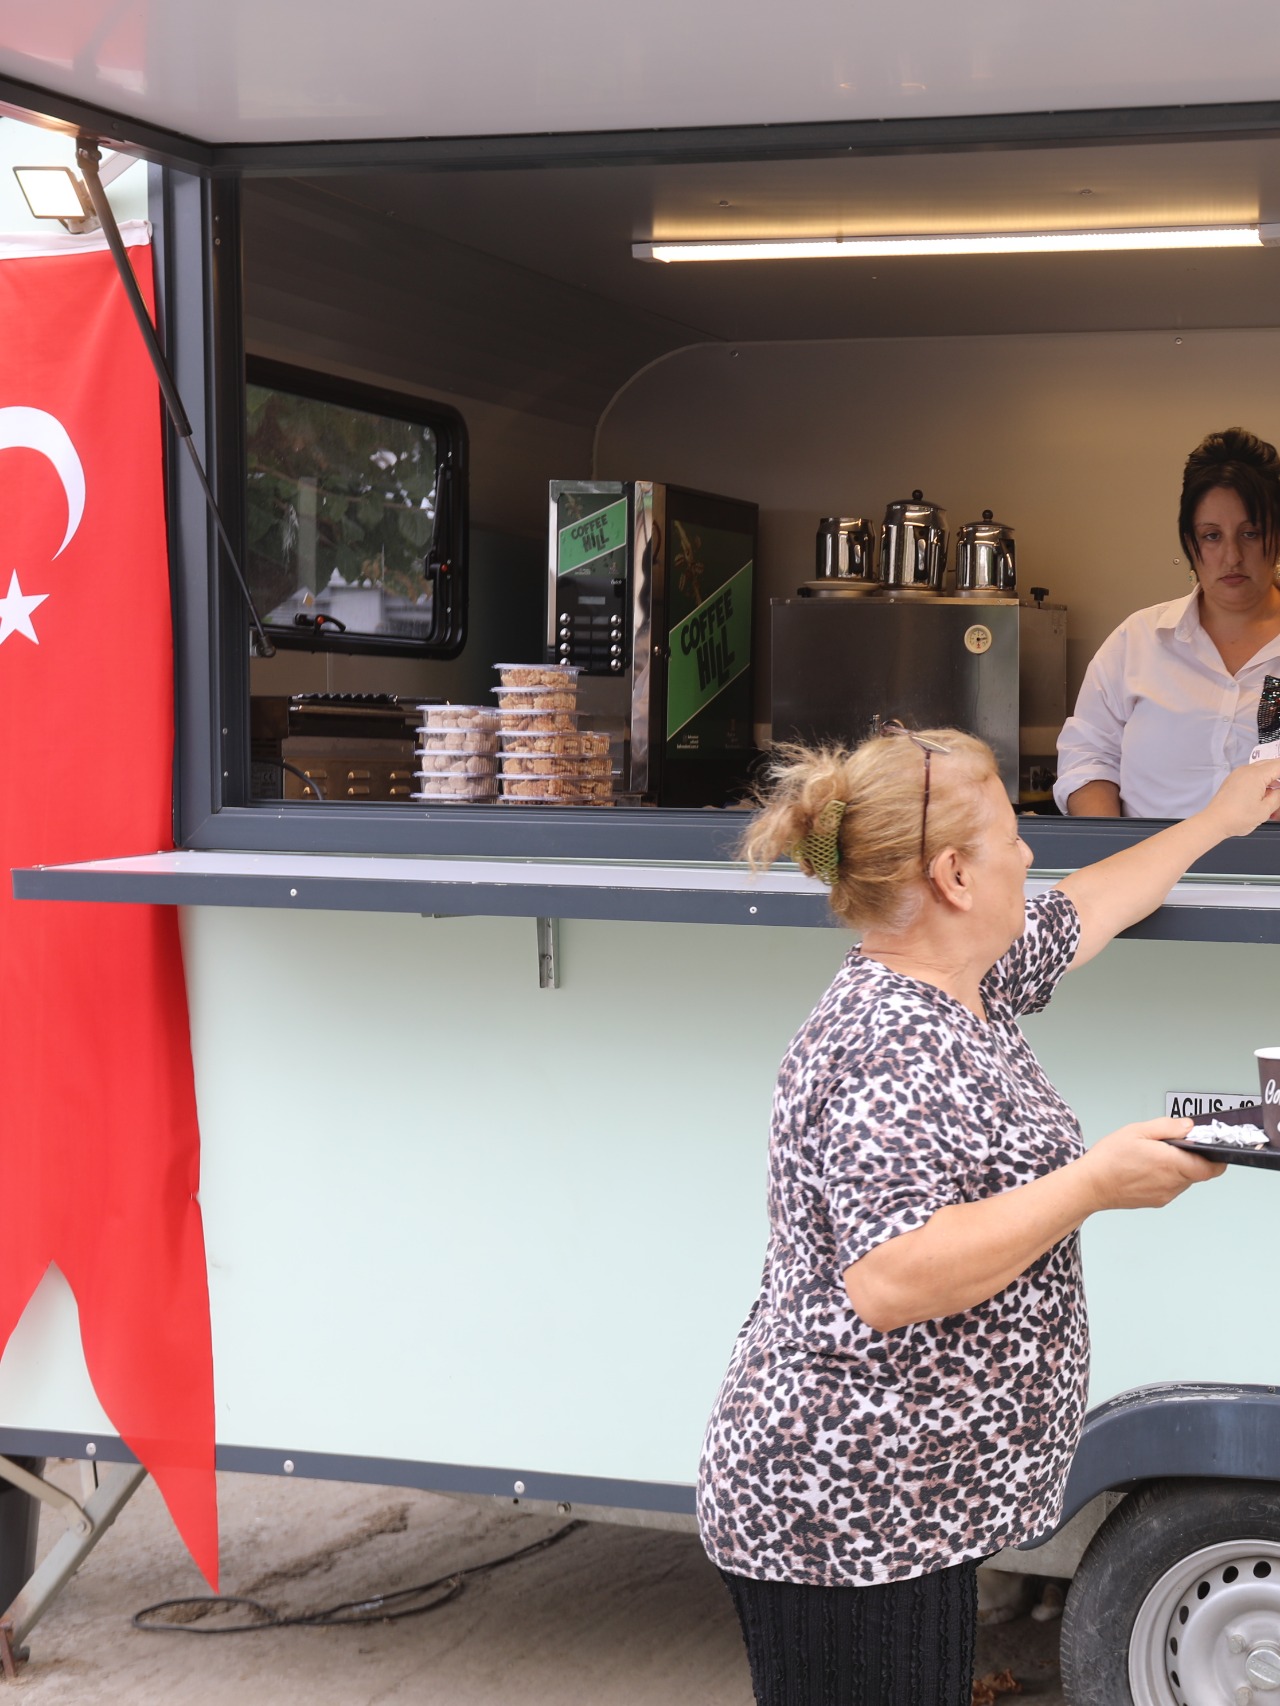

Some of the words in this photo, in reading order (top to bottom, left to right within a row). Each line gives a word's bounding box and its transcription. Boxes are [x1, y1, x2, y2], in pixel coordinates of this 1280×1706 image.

[571, 514, 608, 540] COFFEE
[582, 528, 610, 553] HILL
[681, 587, 734, 656] COFFEE
[696, 624, 736, 692] HILL
